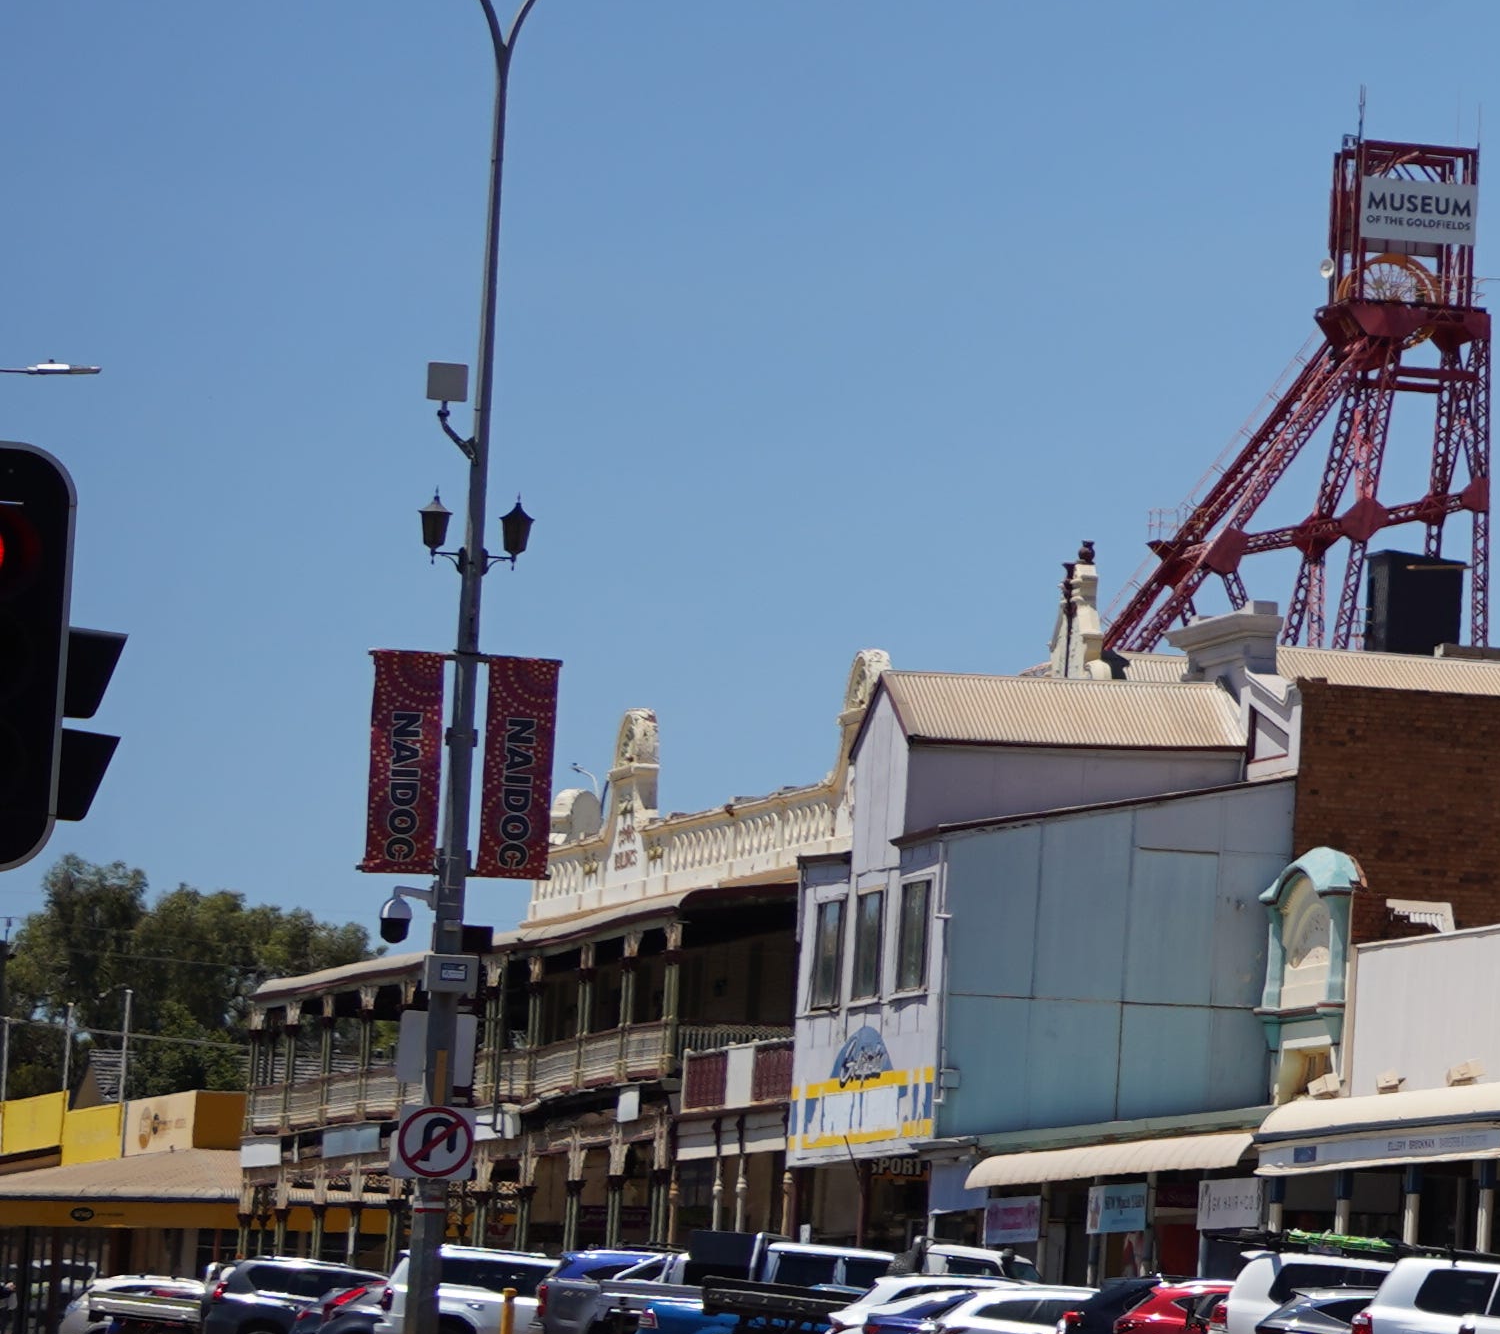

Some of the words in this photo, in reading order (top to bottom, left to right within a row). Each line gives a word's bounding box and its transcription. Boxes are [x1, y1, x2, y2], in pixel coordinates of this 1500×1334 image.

[1367, 191, 1472, 218] MUSEUM
[1366, 214, 1382, 224] OF
[1384, 216, 1404, 227] THE
[1406, 217, 1471, 231] GOLDFIELDS
[385, 711, 424, 862] NAIDOC
[498, 717, 538, 869] NAIDOC
[871, 1157, 922, 1177] SPORT
